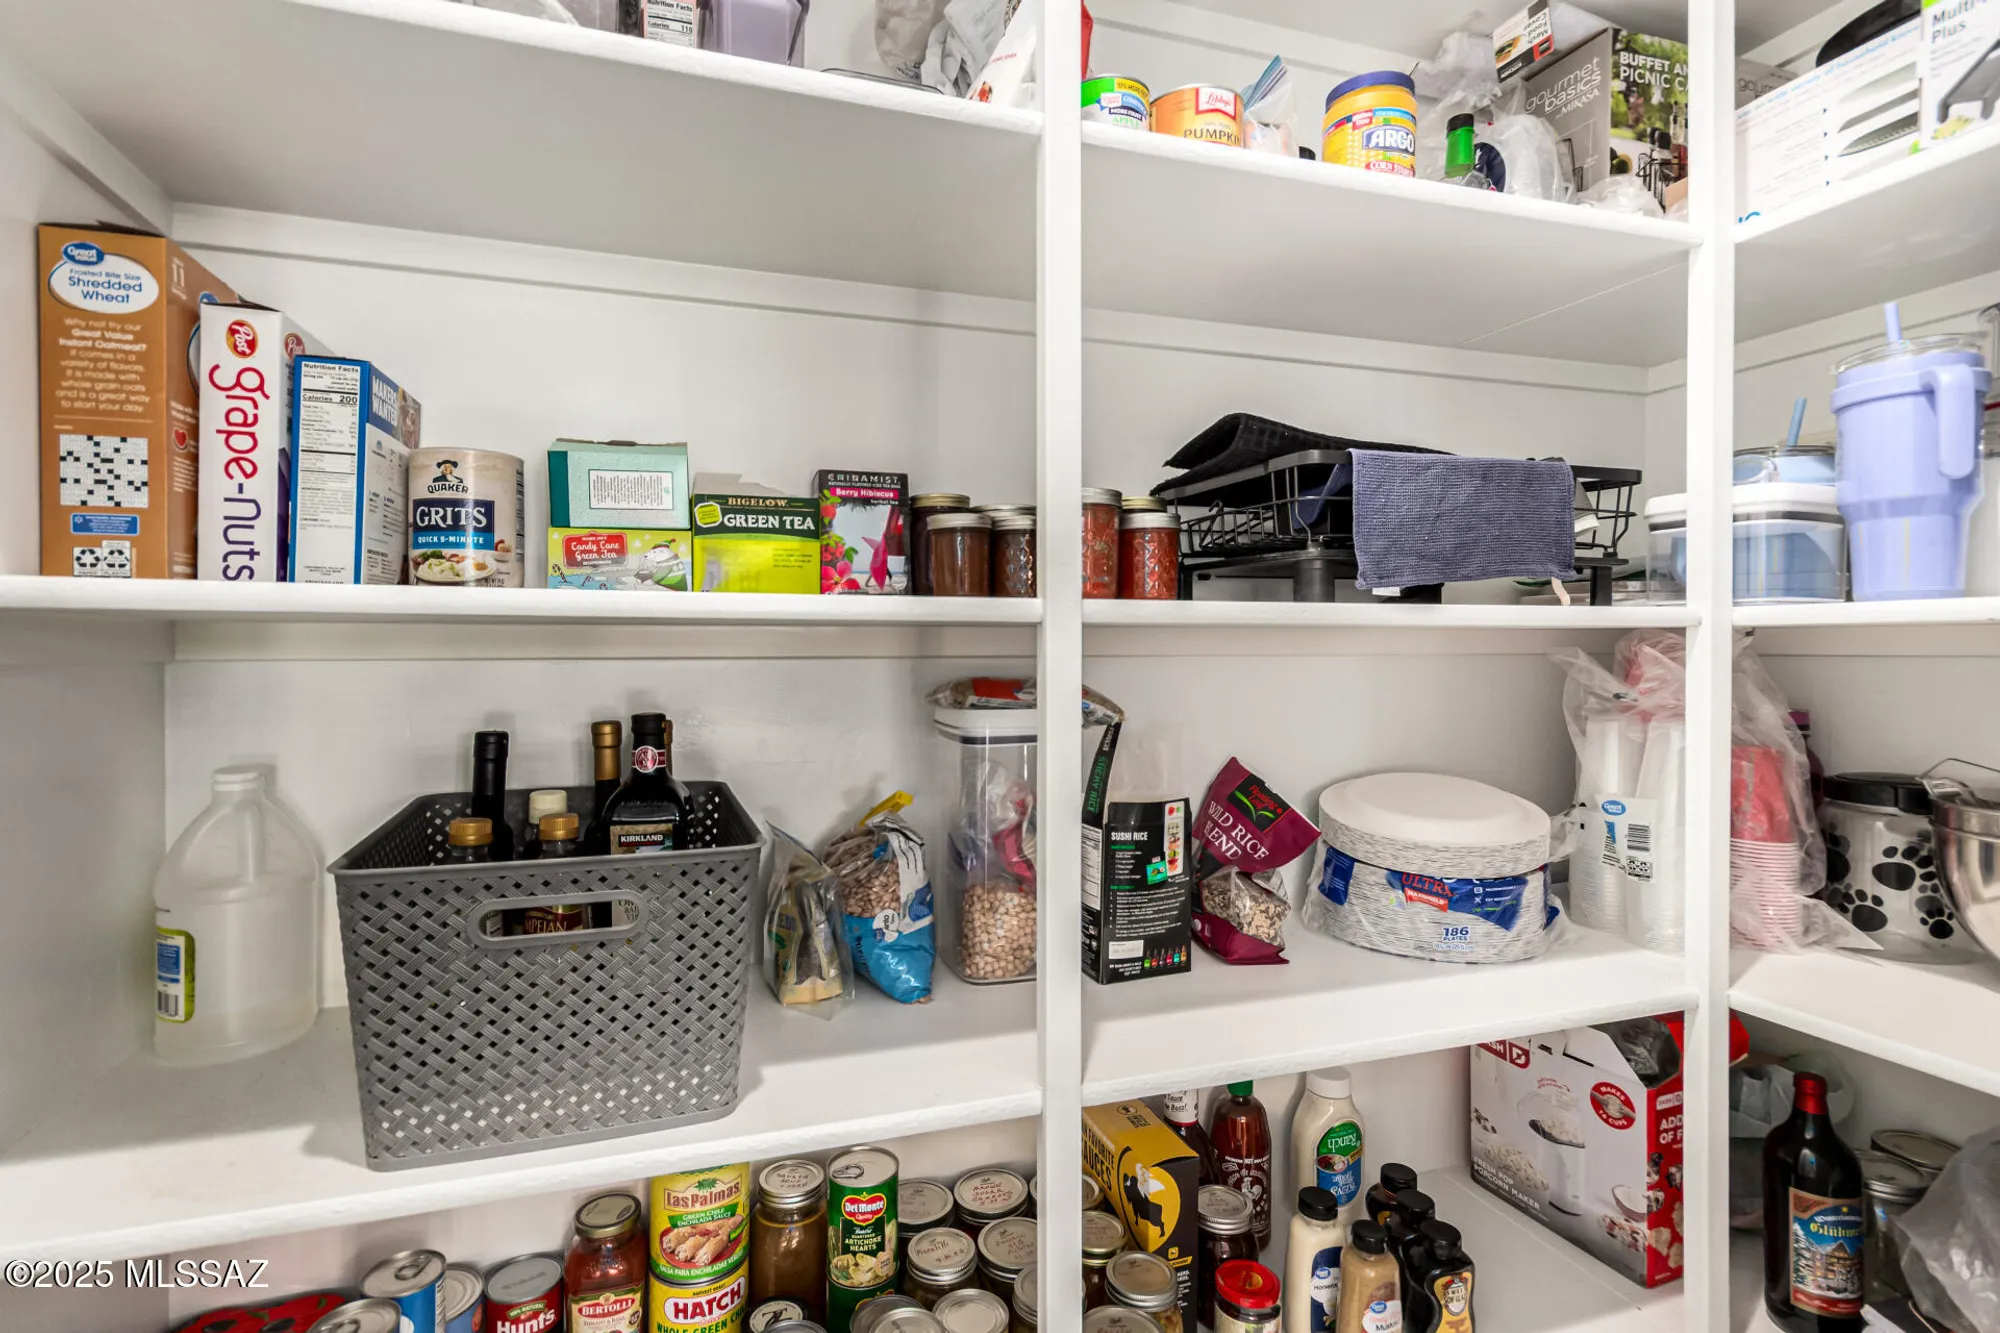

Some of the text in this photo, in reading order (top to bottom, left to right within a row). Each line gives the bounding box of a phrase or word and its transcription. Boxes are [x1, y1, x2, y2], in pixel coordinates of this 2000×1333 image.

[676, 3, 692, 12] Facts
[1524, 12, 1547, 30] Cover
[1528, 22, 1548, 38] Food
[1932, 20, 1966, 43] Plus
[1620, 52, 1670, 72] BUFFET
[1620, 66, 1670, 88] PICNIC
[1525, 56, 1600, 114] gourmet
[1544, 70, 1601, 112] basics
[1560, 88, 1599, 116] MIKASA
[1369, 130, 1414, 152] ARGO
[70, 268, 140, 281] Frosted Bite Size
[68, 276, 142, 292] Shredded
[82, 290, 130, 304] Wheat
[64, 317, 142, 331] Why not try our
[72, 327, 134, 341] Great Value
[232, 322, 254, 358] Post
[58, 338, 146, 352] Instant Oatmeal?
[80, 351, 114, 360] comes
[60, 359, 94, 370] variety
[96, 361, 107, 370] of
[84, 370, 116, 380] made
[118, 371, 140, 382] with
[61, 379, 146, 393] whole grain oats
[56, 389, 78, 399] and
[98, 391, 127, 402] great
[129, 396, 152, 404] way
[302, 394, 358, 404] Calories 200
[61, 400, 72, 408] to
[74, 400, 96, 410] start
[98, 403, 120, 412] your
[208, 364, 270, 582] grape-nuts
[427, 482, 468, 494] QUAKER
[837, 488, 894, 498] Berry Hibiscus
[728, 497, 788, 508] BIGELOW
[416, 506, 488, 528] GRITS
[724, 514, 780, 529] GREEN
[783, 516, 816, 531] TEA
[418, 536, 438, 544] QUICK
[571, 541, 620, 551] Candy Cane
[575, 550, 618, 562] Green Tea
[1111, 832, 1148, 840] SUSHI RICE
[1208, 801, 1269, 860] WILD RICE
[620, 834, 664, 843] KIRKLAND
[1204, 820, 1242, 860] LEND
[1402, 872, 1452, 897] ULTRA
[1443, 926, 1470, 938] 186
[1600, 1086, 1626, 1101] MAKES
[1608, 1117, 1628, 1127] CUPS
[1660, 1116, 1684, 1130] ADD
[1328, 1133, 1356, 1152] Ranch
[1660, 1131, 1675, 1145] OF
[1083, 1140, 1112, 1192] AUCES
[1474, 1156, 1514, 1186] FRESH POP
[666, 1181, 740, 1208] Las Palmas
[1474, 1164, 1541, 1212] POPCORN MAKER
[682, 1208, 725, 1220] GREEN CHILE
[844, 1200, 884, 1213] Del Monte
[677, 1211, 732, 1227] ENCHILADA SAUCE
[844, 1236, 882, 1244] ARTICHOKE
[850, 1243, 878, 1252] HEARTS
[660, 1264, 674, 1275] SALSA
[674, 1268, 690, 1276] PARA
[690, 1260, 728, 1276] ENCHILADAS
[582, 1298, 632, 1316] BERTOLLI
[673, 1281, 742, 1320] HATCH
[693, 1317, 728, 1333] GREEN
